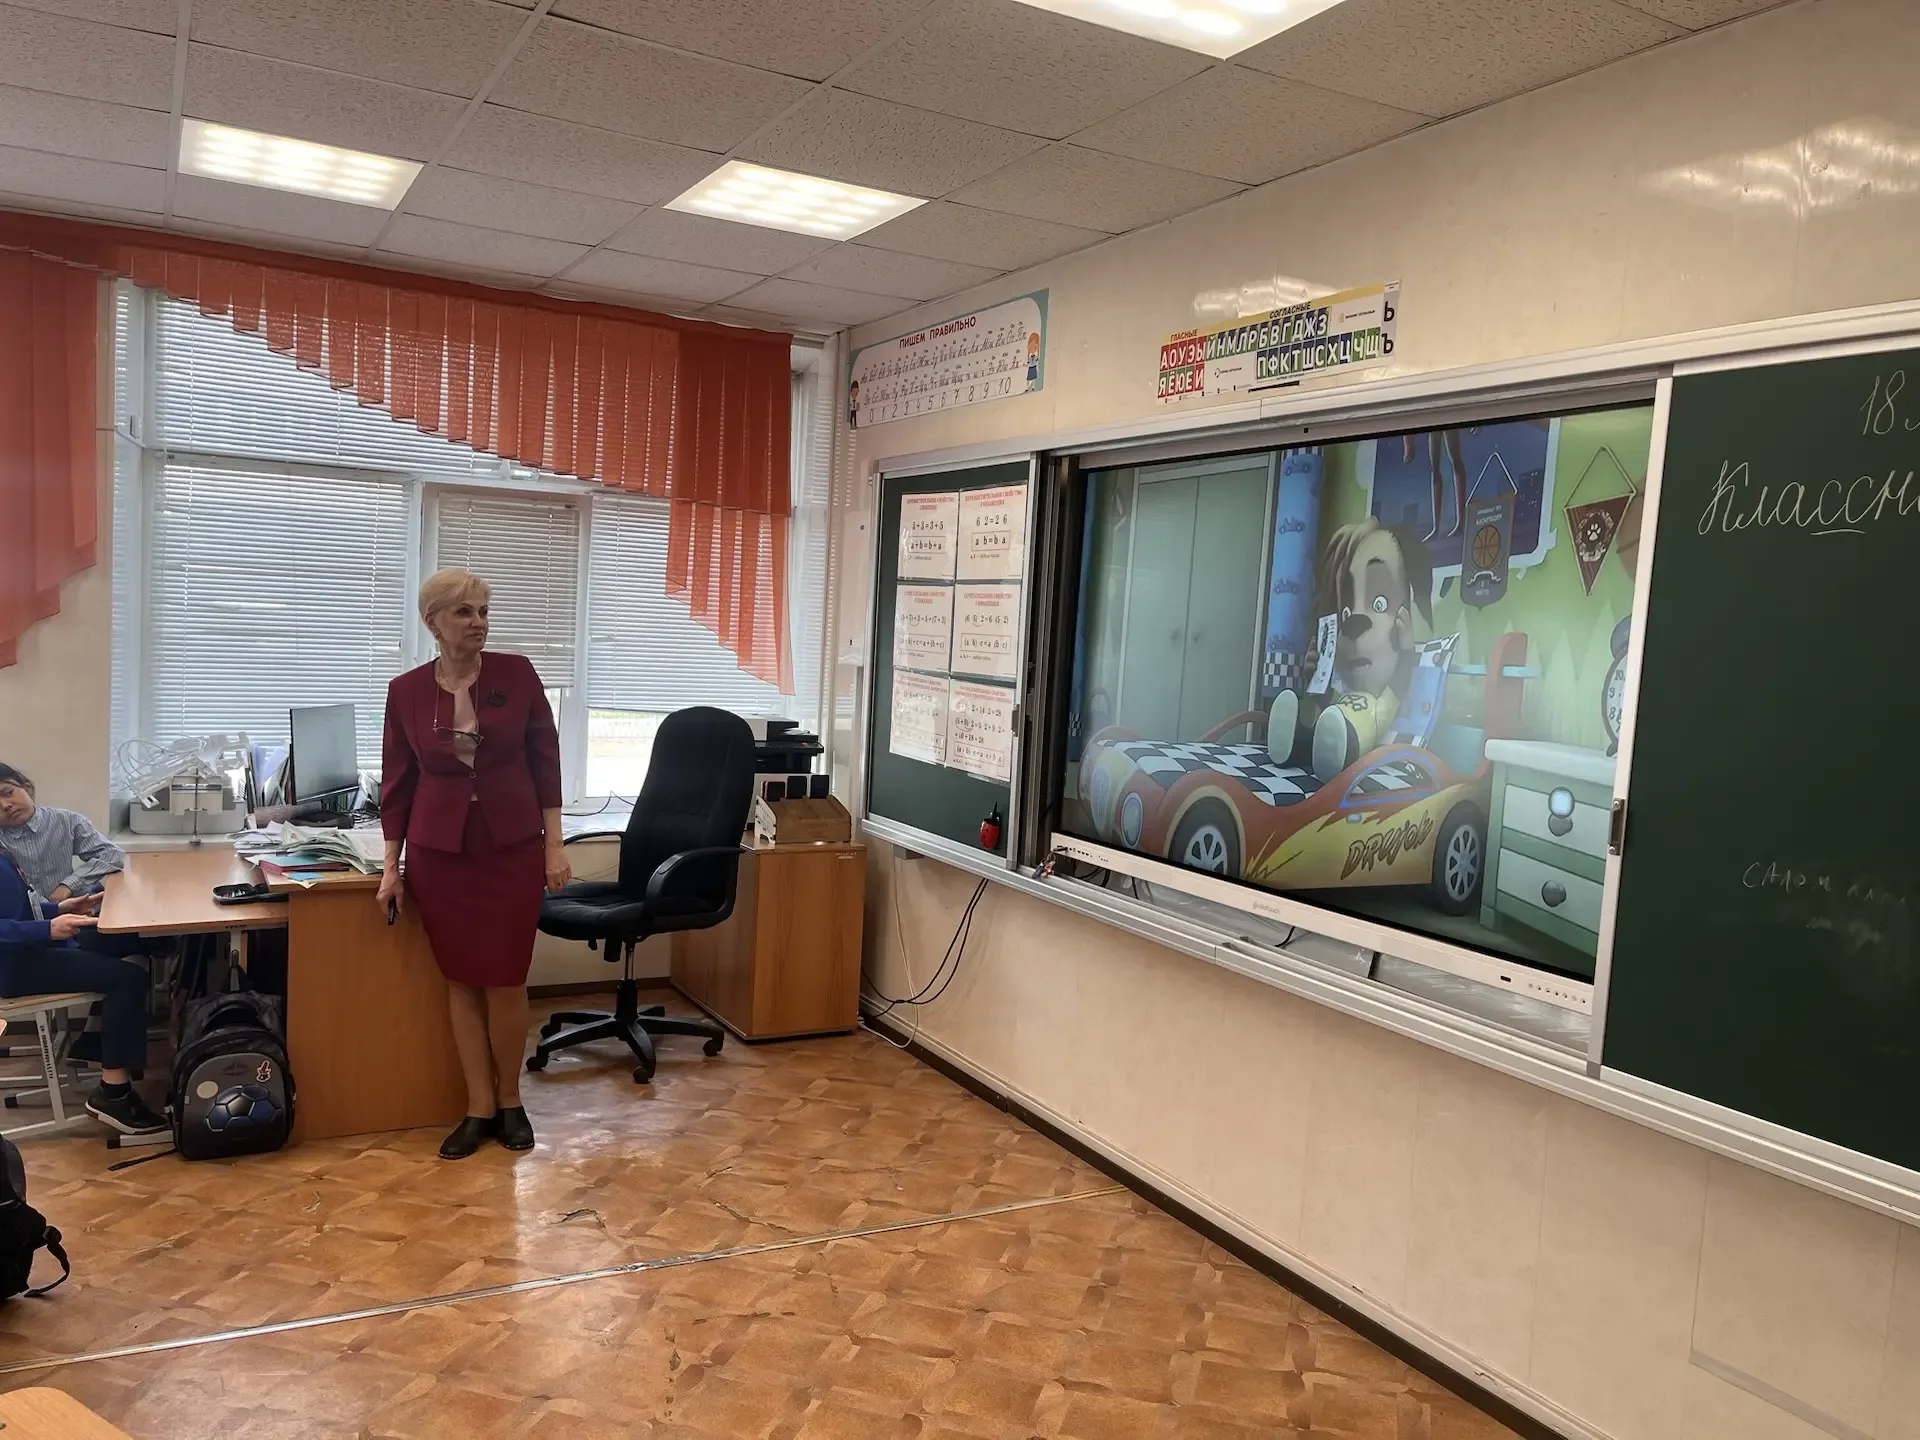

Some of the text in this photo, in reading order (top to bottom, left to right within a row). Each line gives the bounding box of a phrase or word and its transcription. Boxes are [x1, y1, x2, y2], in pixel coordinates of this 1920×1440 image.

[1270, 302, 1312, 319] СОГЛАСНЫЕ
[899, 316, 977, 350] ПИШЕМ ПРАВИЛЬНО
[1170, 328, 1199, 342] ГЛАСНЫЕ
[1859, 369, 1906, 436] 18
[1698, 459, 1920, 536] Классн
